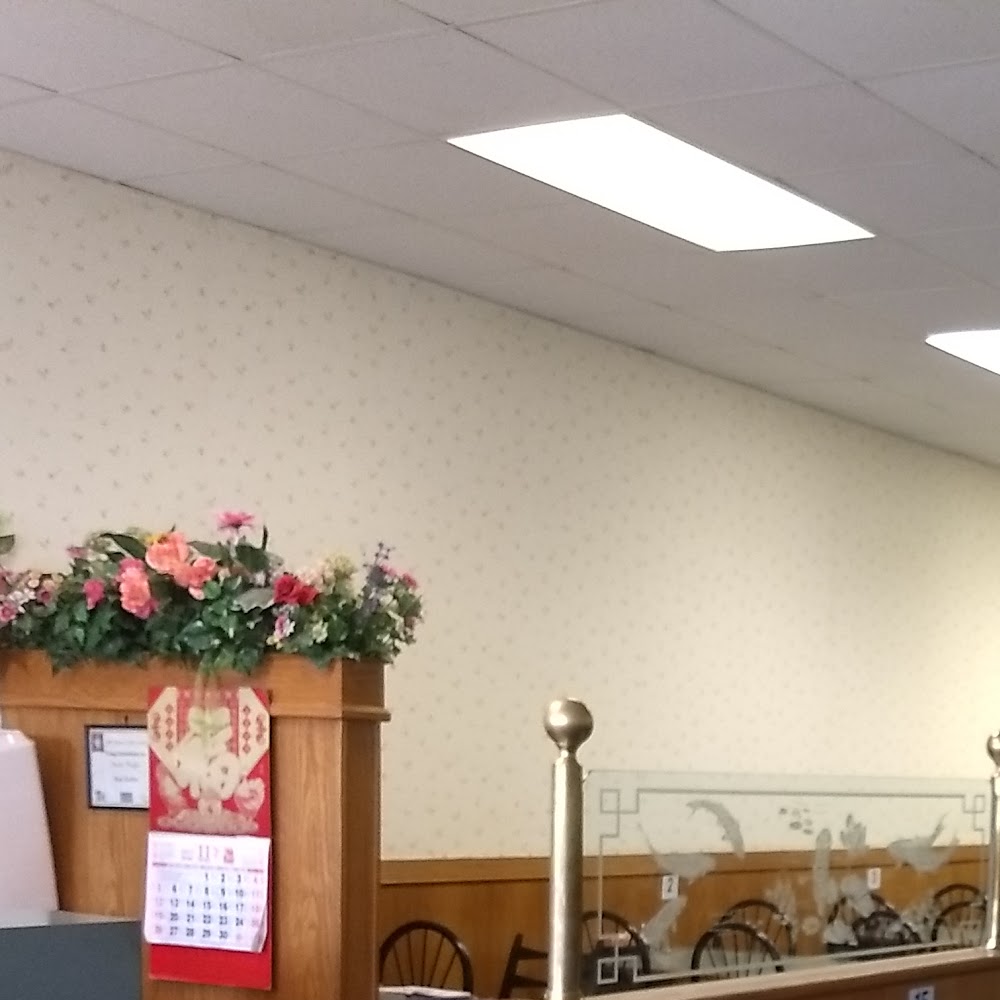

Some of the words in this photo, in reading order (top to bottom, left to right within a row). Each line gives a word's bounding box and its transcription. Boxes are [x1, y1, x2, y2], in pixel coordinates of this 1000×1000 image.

[221, 873, 225, 883] 2
[237, 874, 241, 884] 3
[667, 877, 674, 893] 2
[172, 884, 177, 893] 6
[189, 885, 193, 895] 7
[204, 887, 209, 896] 8
[221, 888, 226, 897] 9
[235, 889, 244, 898] 10
[170, 898, 179, 908] 13
[186, 900, 195, 908] 14
[203, 901, 212, 910] 15
[219, 902, 228, 911] 16
[235, 903, 244, 912] 17
[170, 912, 179, 921] 20
[186, 914, 195, 923] 21
[203, 914, 211, 924] 22
[219, 915, 228, 925] 23
[235, 917, 244, 927] 24
[170, 926, 178, 936] 27
[186, 928, 195, 937] 28
[202, 929, 211, 938] 29
[219, 930, 228, 940] 30
